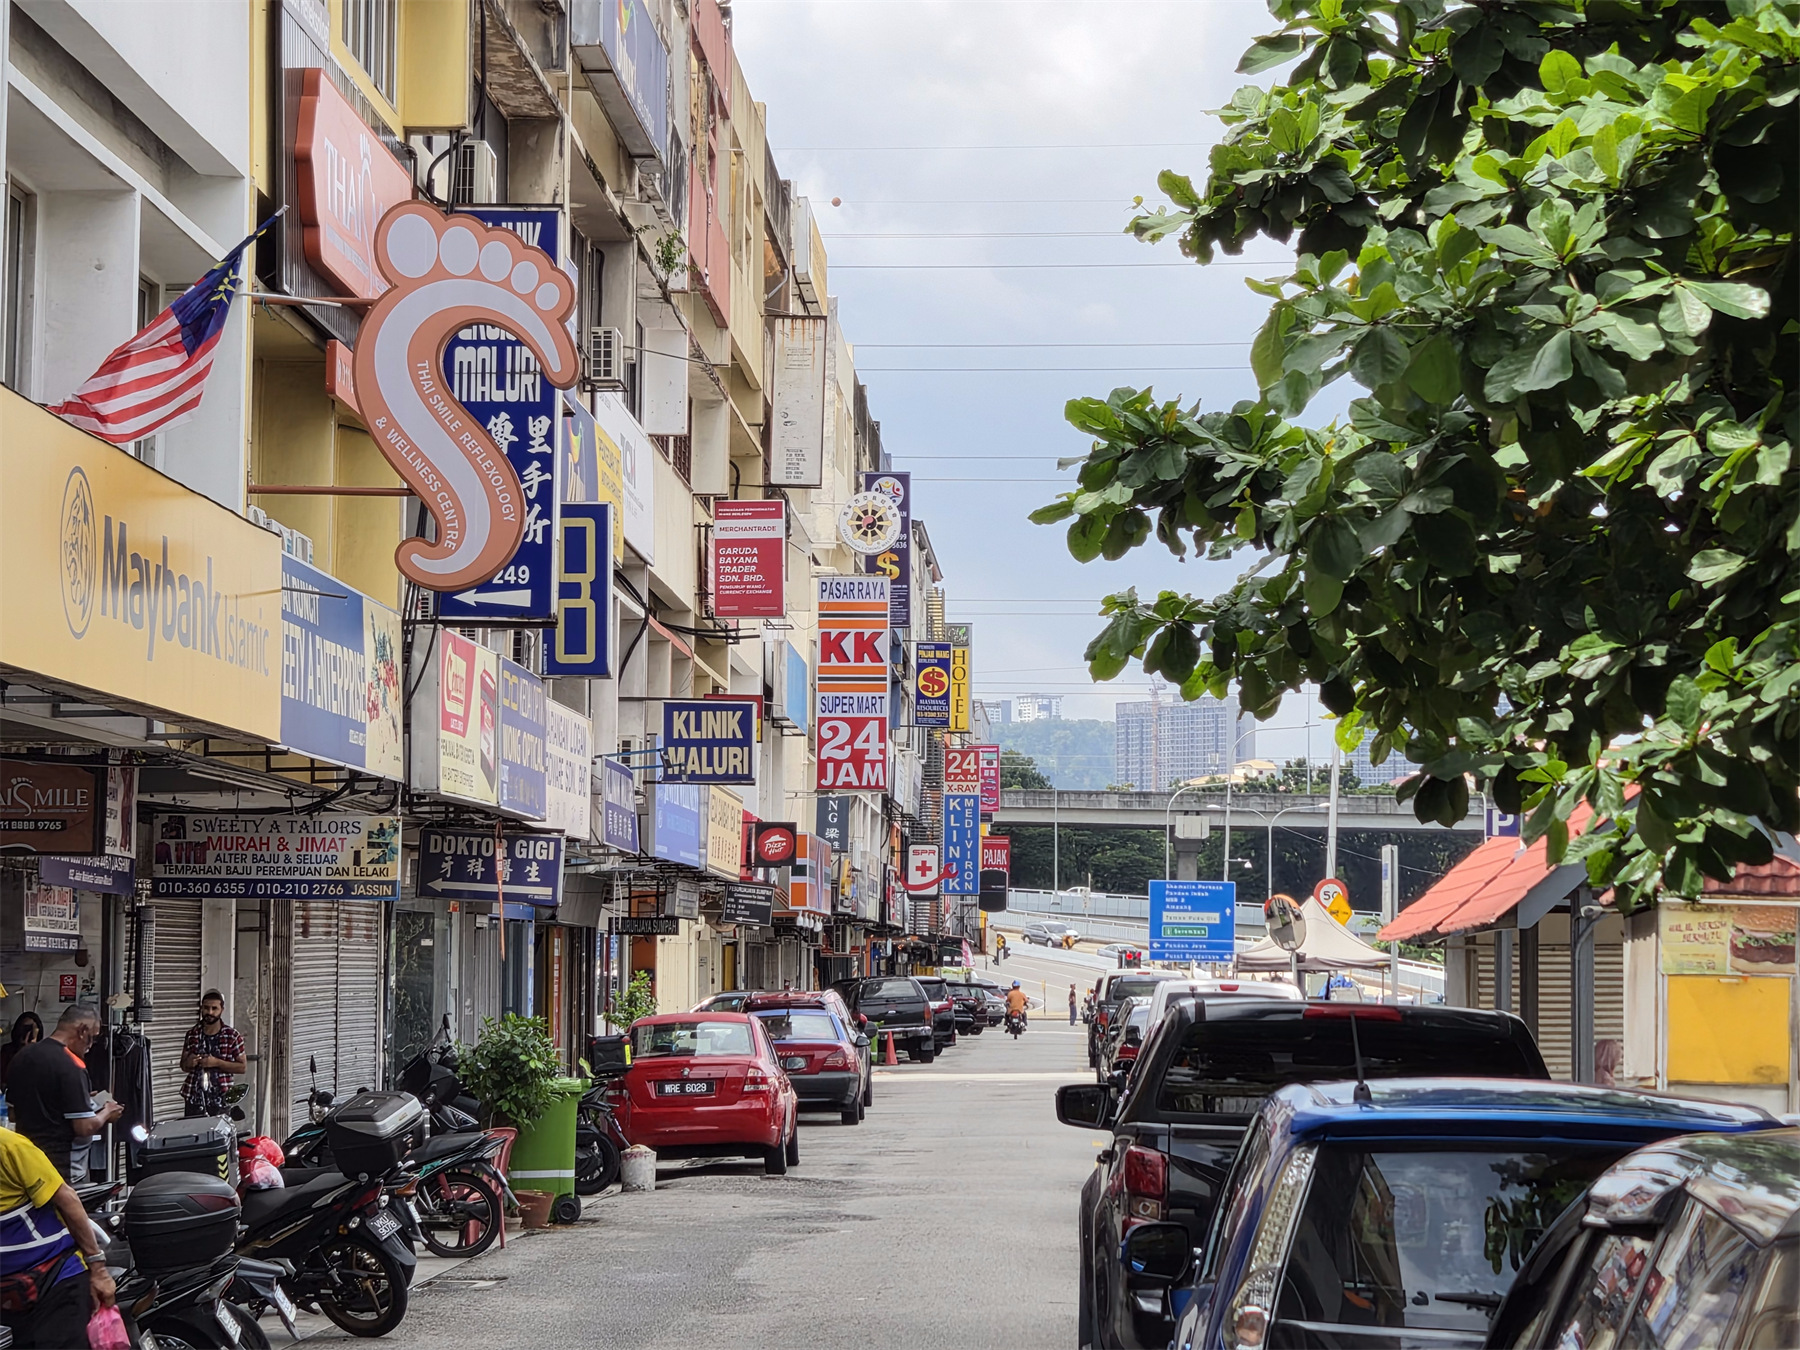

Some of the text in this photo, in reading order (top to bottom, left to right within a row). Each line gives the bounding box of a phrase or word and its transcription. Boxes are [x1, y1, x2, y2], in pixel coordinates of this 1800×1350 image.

[454, 346, 540, 402] MALURI
[417, 359, 516, 522] THAI SMILE REFLEXOLOGY
[375, 416, 460, 550] & WELLNESS CENTRE
[719, 547, 758, 555] GARUDA
[719, 565, 756, 573] TRADER
[719, 574, 765, 582] SDN. BHD.
[101, 514, 270, 677] Maybank Islamic
[820, 631, 885, 664] KK
[307, 631, 315, 706] A
[315, 634, 366, 724] ENTERPRISE
[952, 649, 967, 730] HOTEL
[820, 696, 885, 714] SUPER MART
[672, 710, 743, 739] KLINIK
[522, 731, 545, 774] OPTICAL
[820, 720, 886, 761] 24
[667, 746, 749, 775] MALURI
[947, 751, 977, 774] 24
[820, 763, 885, 787] JAM
[946, 783, 978, 793] X-RAY
[37, 821, 62, 829] 9765
[192, 818, 362, 835] SWEETY A TAILORS
[1492, 810, 1514, 835] P
[206, 836, 348, 853] MURAH & JIMAT
[429, 835, 555, 860] DOKTOR GIGI
[964, 798, 974, 891] MEDIVIRON
[213, 854, 338, 865] ALTER BAJU & SELUAR
[983, 849, 1007, 865] PAJAK
[163, 865, 389, 878] TEMPAHAN BAJU PEREMPUAN DAN LELAKI
[158, 881, 211, 895] 010-360
[214, 882, 246, 895] 6355
[256, 883, 309, 895] 010-210
[312, 883, 344, 896] 2766
[350, 884, 393, 896] JASSIN
[665, 1083, 707, 1093] WRE 6029
